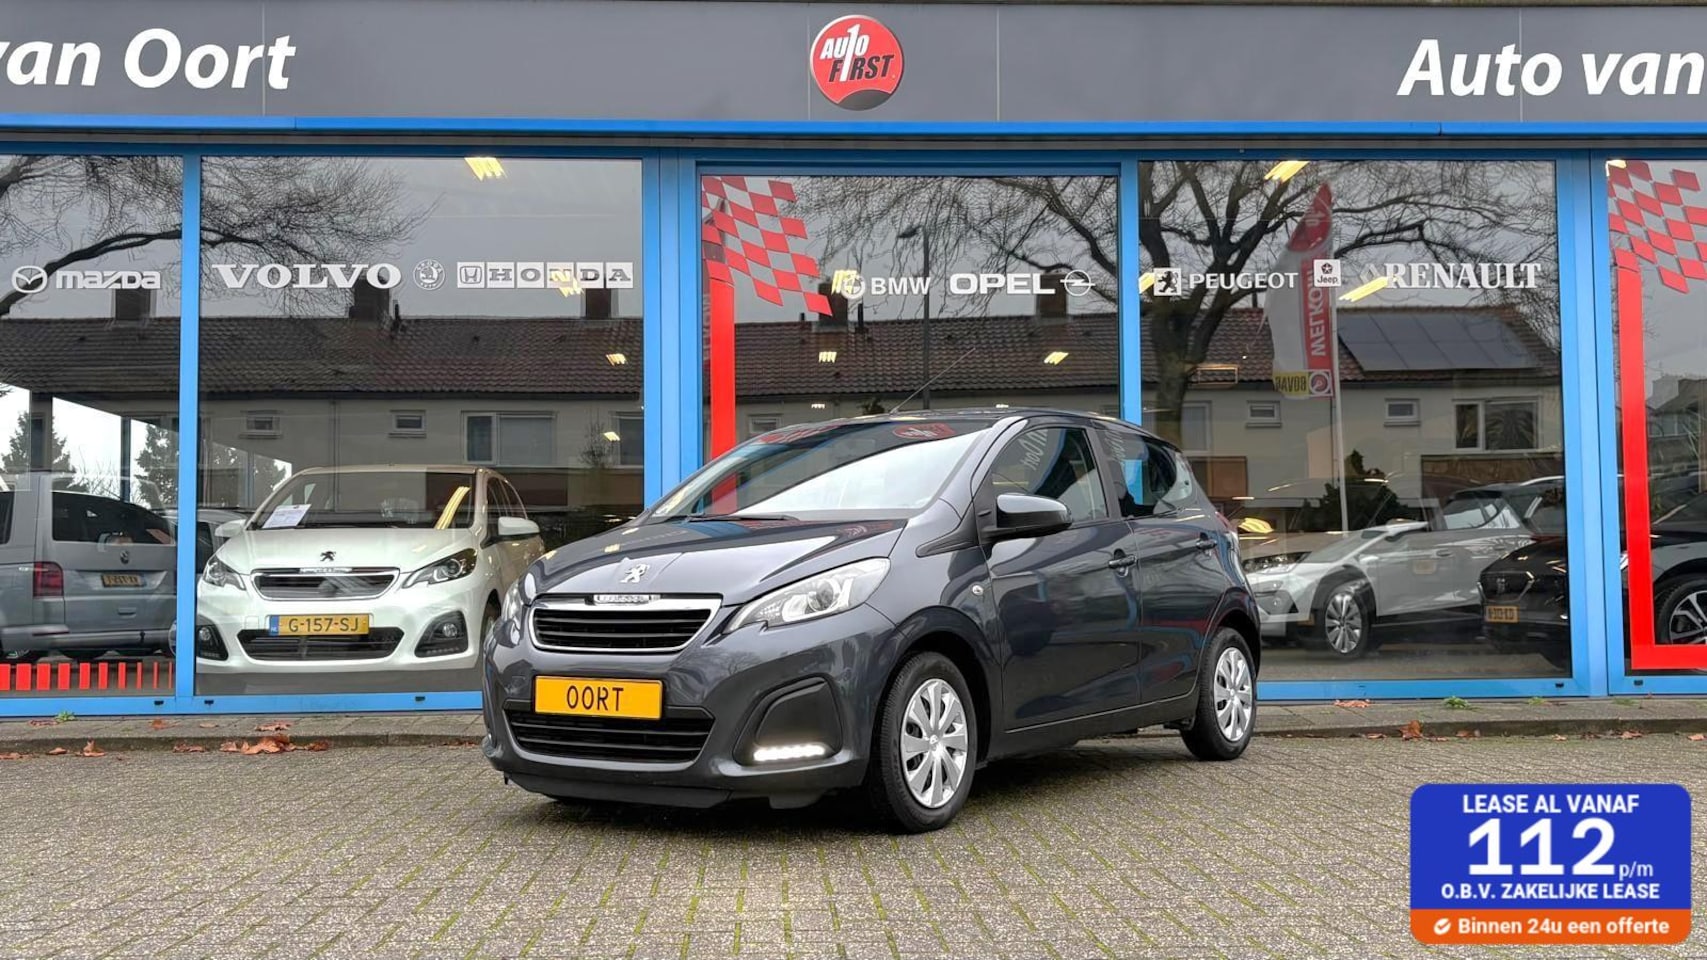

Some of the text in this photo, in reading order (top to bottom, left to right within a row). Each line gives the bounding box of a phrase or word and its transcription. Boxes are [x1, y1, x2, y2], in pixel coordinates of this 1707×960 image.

[0, 28, 297, 90] an Oort
[1396, 39, 1705, 97] Auto van
[211, 263, 403, 290] VOLVO
[488, 267, 633, 283] HONDA
[871, 277, 931, 295] BMW
[949, 273, 1056, 295] OPEL
[1189, 272, 1299, 290] PEUGEOT
[1317, 275, 1338, 285] Jeep
[1384, 262, 1542, 290] RENAULT
[288, 617, 359, 633] G-157-SJ
[566, 685, 625, 712] OORT
